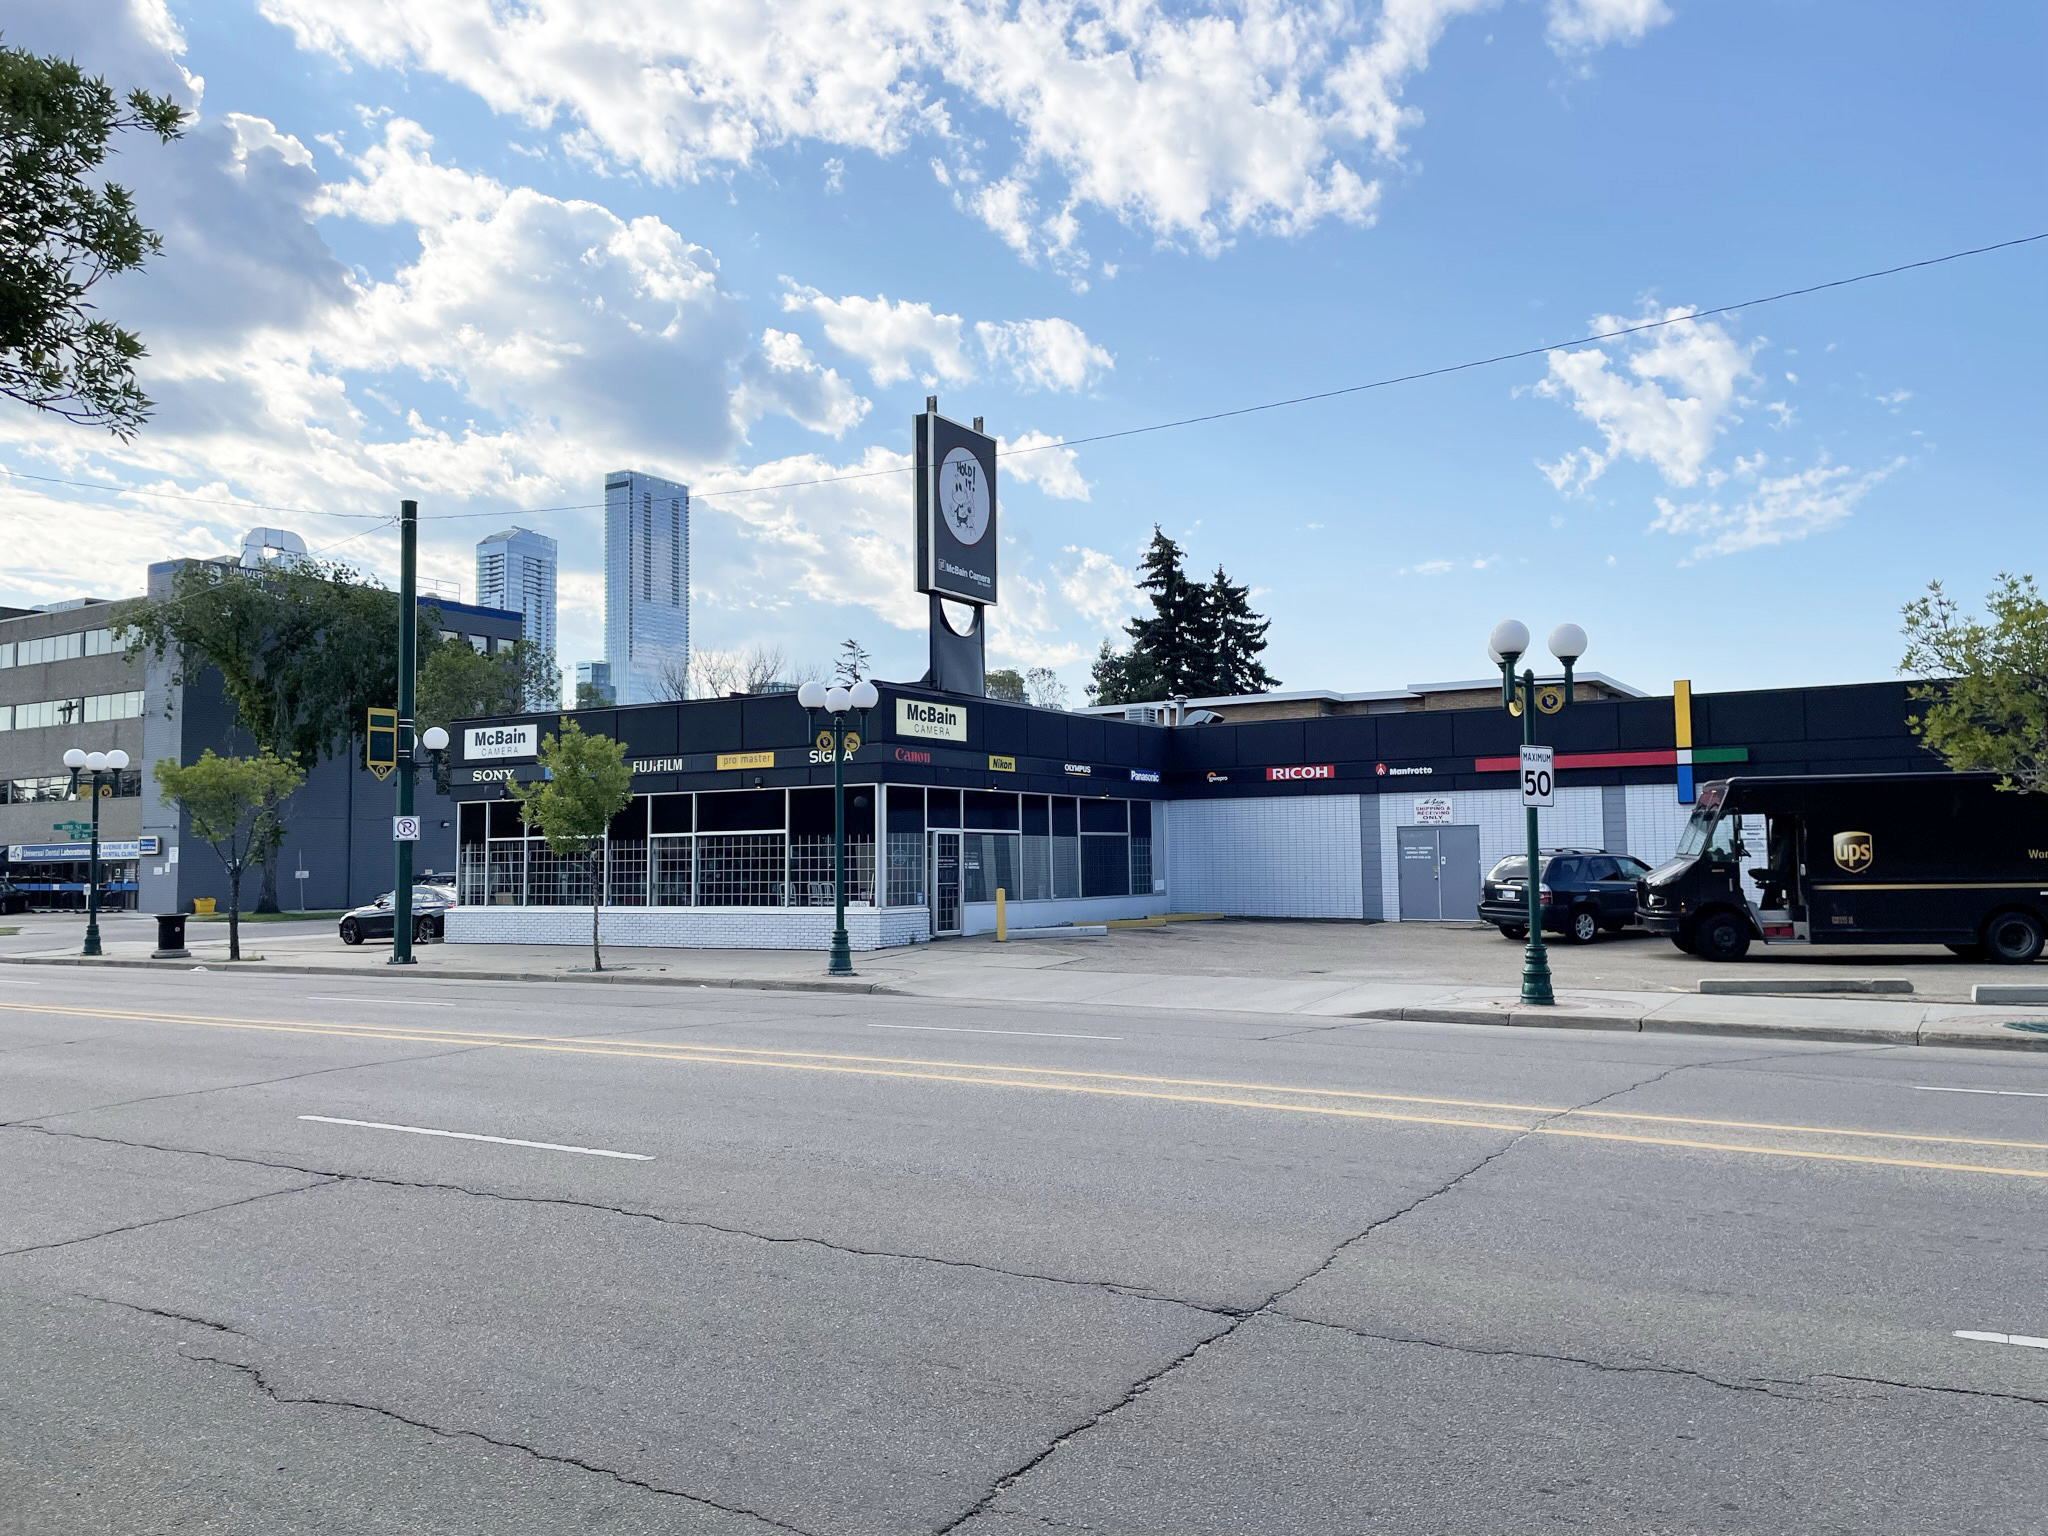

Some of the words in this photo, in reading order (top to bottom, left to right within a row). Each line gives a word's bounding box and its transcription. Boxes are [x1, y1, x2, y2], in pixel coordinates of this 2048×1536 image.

[957, 461, 973, 477] HOLD
[946, 562, 968, 578] McBain
[969, 569, 991, 584] Camera
[906, 703, 957, 726] McBain
[474, 727, 526, 747] McBain
[914, 723, 951, 737] CAMERA
[481, 746, 519, 757] CAMERA
[895, 747, 931, 764] Canon
[1523, 752, 1552, 763] MAXIMUM
[632, 758, 683, 773] FUJIFILM
[723, 756, 737, 768] pro
[741, 754, 771, 764] master
[992, 758, 1013, 770] Nikon
[1064, 762, 1092, 773] OLYMPUS
[472, 768, 515, 782] SONY
[1130, 770, 1160, 783] Panasonic
[1272, 766, 1328, 780] RICOH
[1389, 766, 1433, 776] Manfrotto
[1524, 769, 1551, 797] 50
[23, 849, 45, 857] Universal
[45, 848, 60, 857] Dental
[61, 846, 91, 855] Laboratories
[1836, 843, 1870, 867] ups
